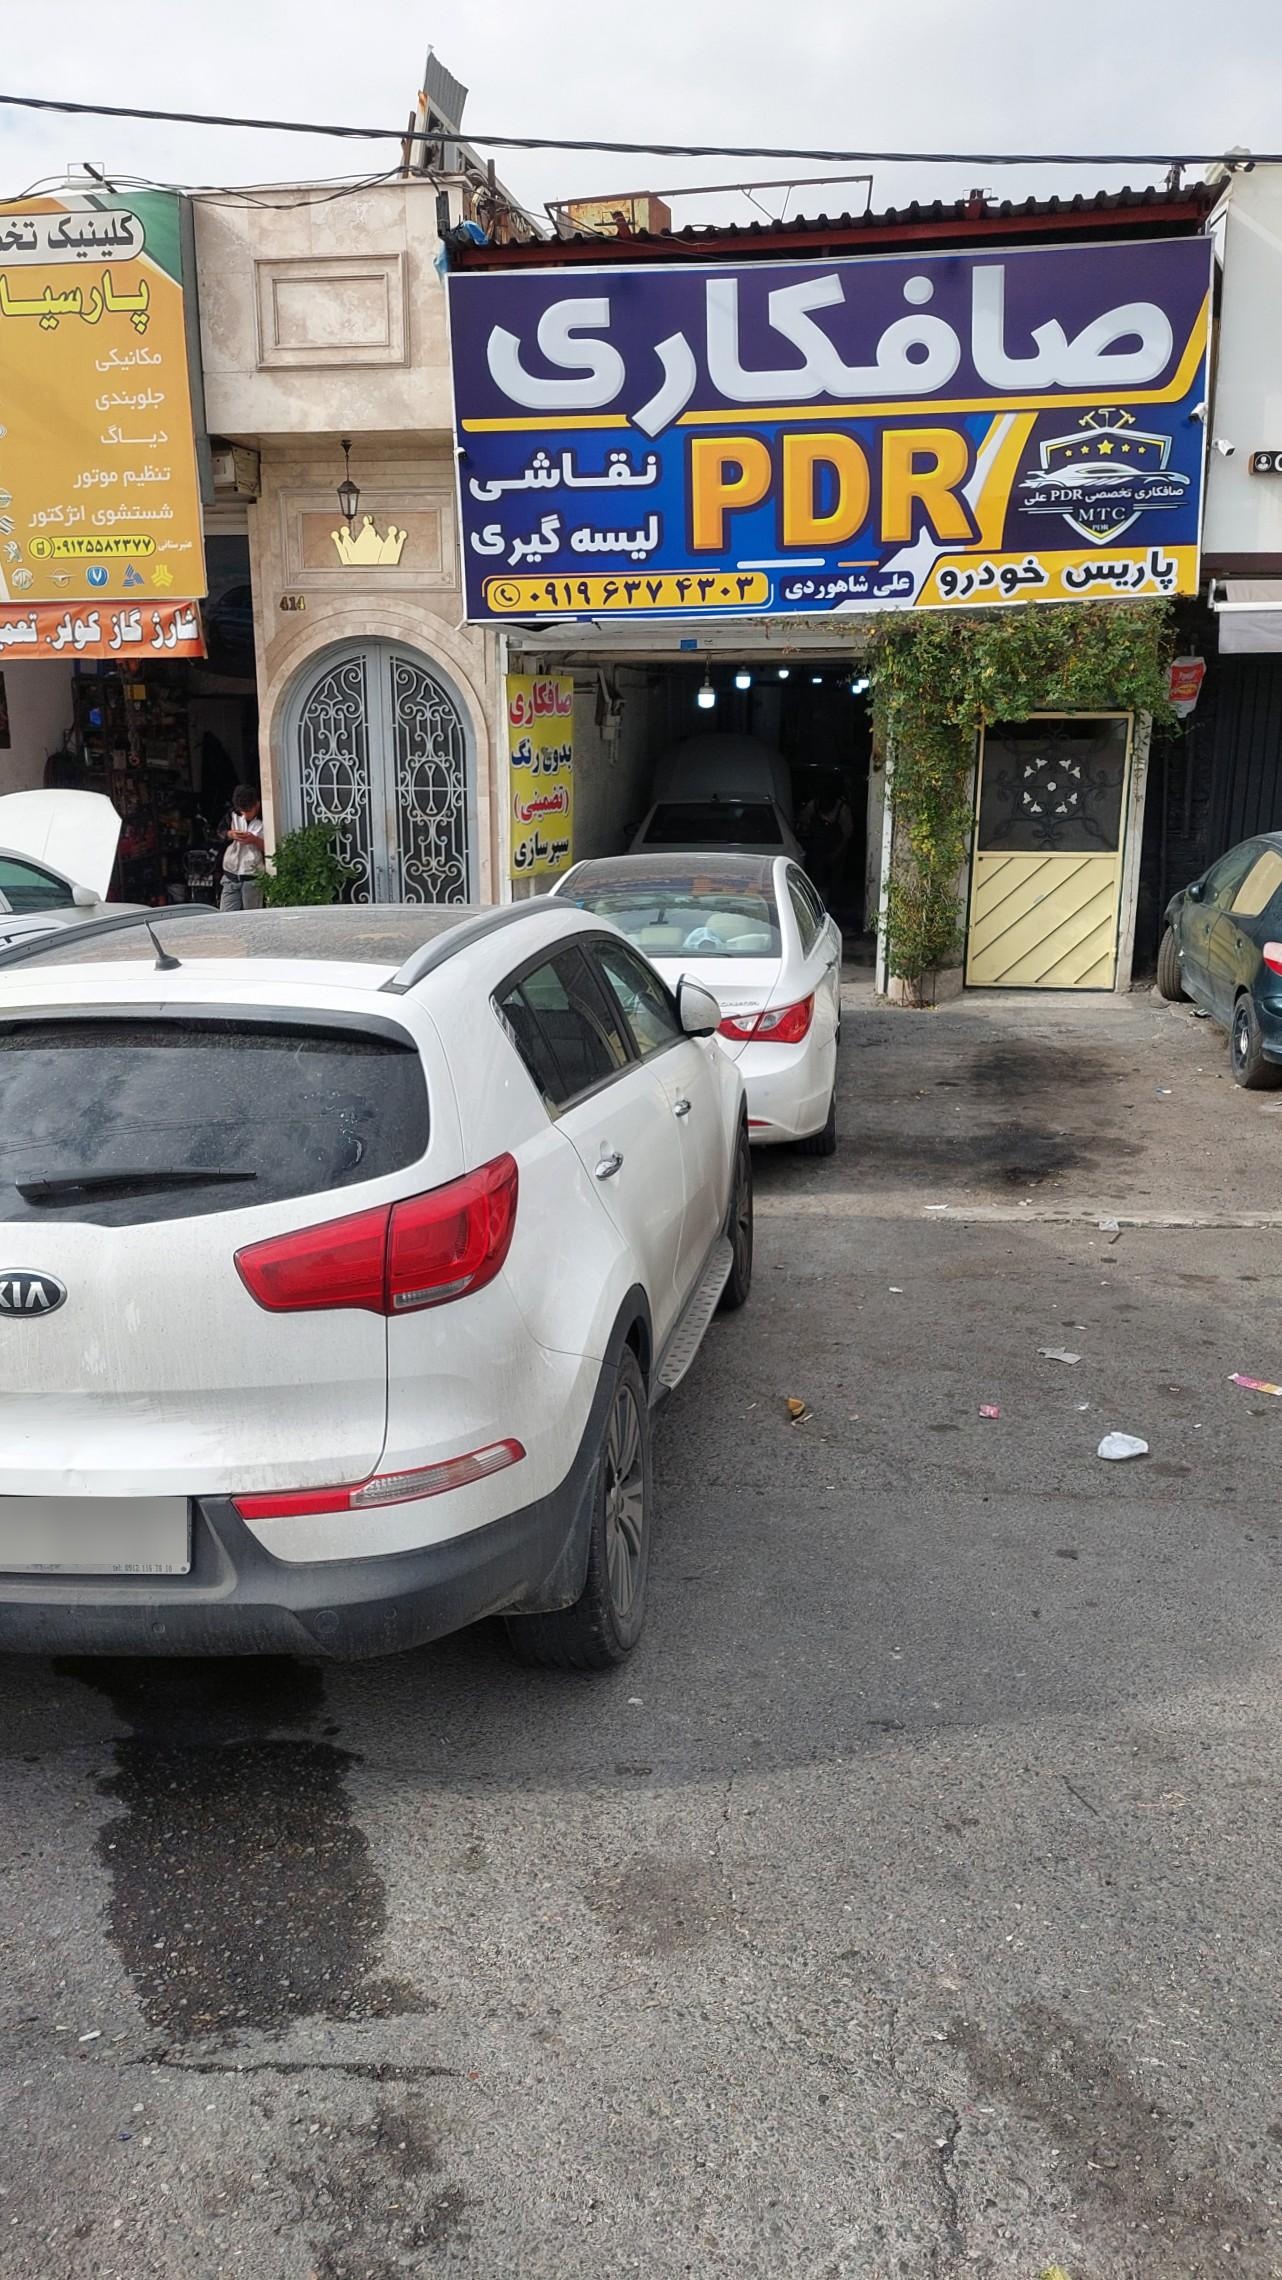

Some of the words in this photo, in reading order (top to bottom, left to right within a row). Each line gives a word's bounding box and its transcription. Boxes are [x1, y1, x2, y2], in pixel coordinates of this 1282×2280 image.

[0, 220, 37, 251] تخ
[48, 215, 133, 258] کلینیک
[95, 348, 162, 371] مکانیکی
[487, 264, 1173, 437] صافکاری
[95, 387, 165, 410] جلوبندی
[100, 425, 168, 447] دیاگ
[73, 469, 118, 488] موتور
[123, 465, 171, 487] تنظیم
[469, 452, 657, 501] نقاشی
[691, 428, 974, 549] PDR
[1024, 492, 1047, 505] علی
[1051, 489, 1082, 501] PDR
[1085, 488, 1131, 502] تخصصی
[1134, 486, 1184, 499] صافکاری
[28, 505, 85, 527] انژکتور
[91, 503, 174, 526] شستشوی
[1078, 507, 1126, 521] MTC
[470, 514, 560, 566] گیری
[570, 516, 659, 560] لیسه
[939, 559, 1045, 596] خودرو
[1065, 551, 1174, 590] پاریس
[529, 580, 591, 607] ۰۹۱۹
[785, 575, 869, 600] شاهوردی
[873, 573, 910, 597] علی
[280, 595, 306, 611] 414
[108, 608, 143, 650] گاز
[151, 608, 199, 650] شارژ
[509, 679, 572, 726] صافکاری
[511, 737, 540, 774] رنگ
[0, 1281, 51, 1308] KIA
